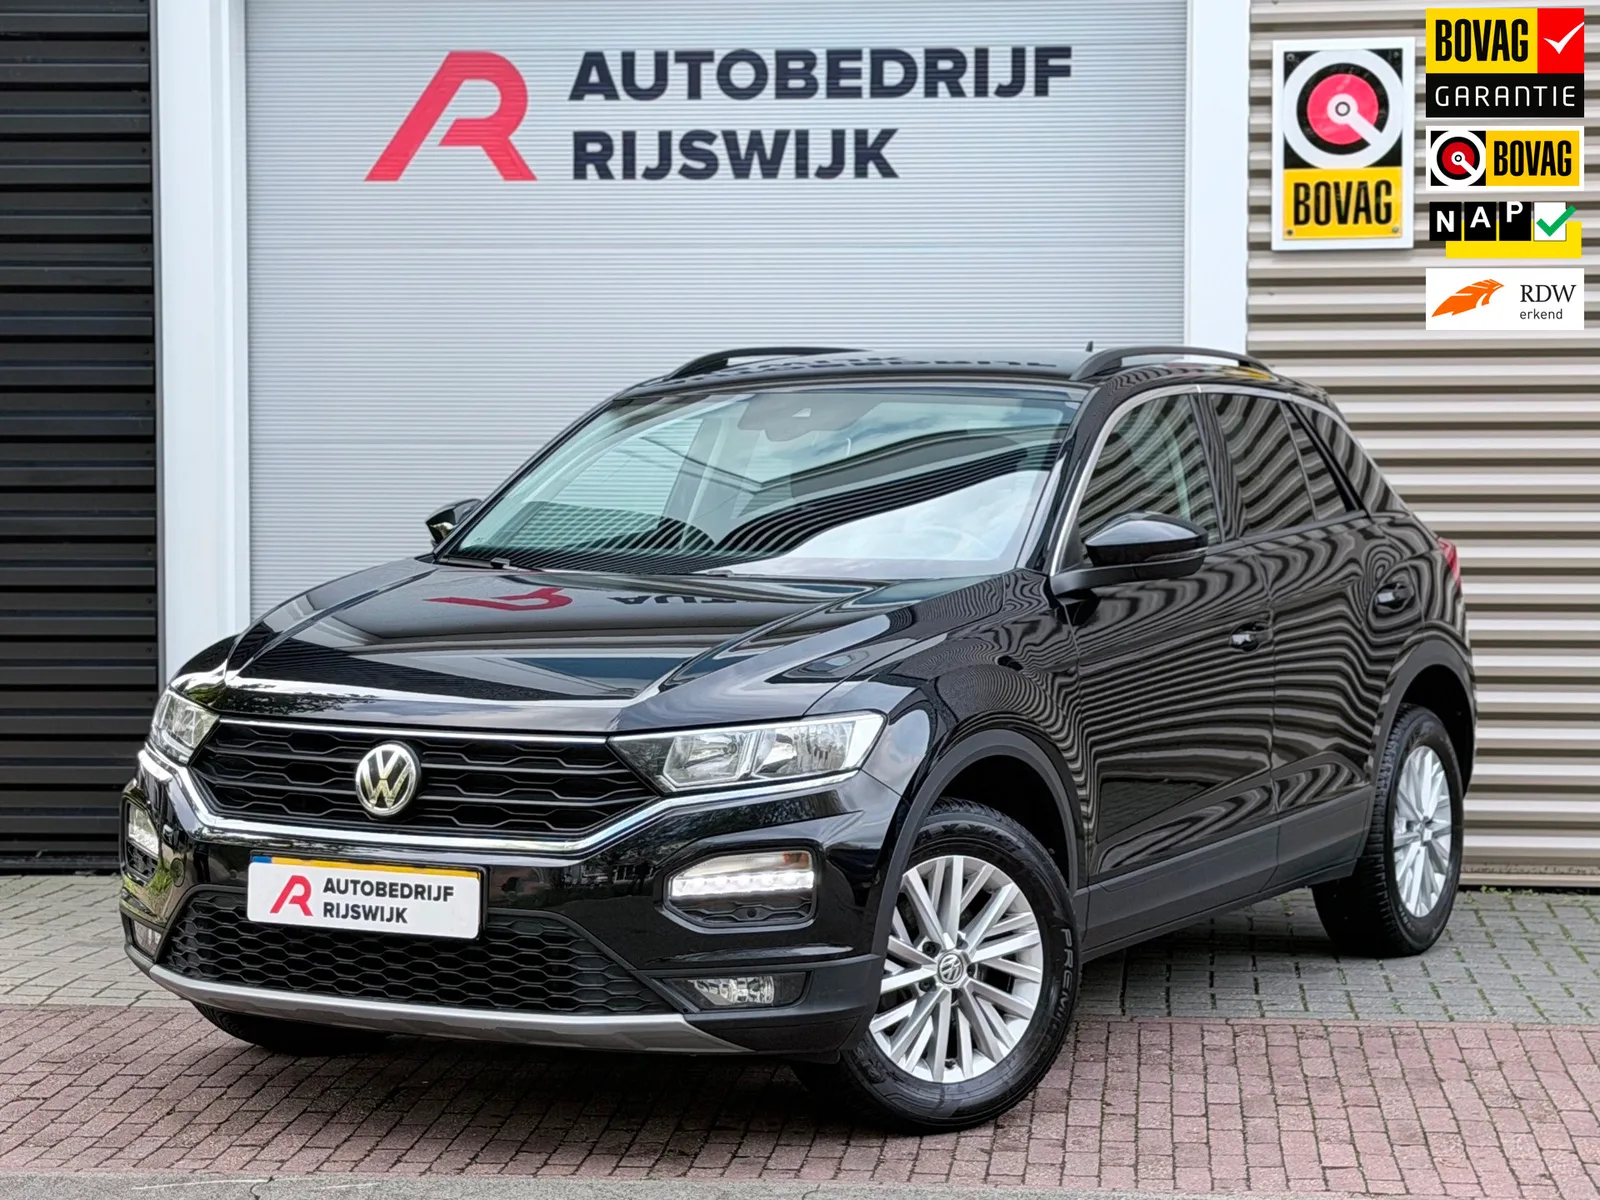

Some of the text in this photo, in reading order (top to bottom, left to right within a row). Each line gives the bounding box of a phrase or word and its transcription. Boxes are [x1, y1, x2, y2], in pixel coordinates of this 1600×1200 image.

[568, 46, 1072, 101] AUTOBEDRIJF
[573, 128, 899, 181] RIJSWIJK
[1293, 180, 1393, 226] BOVAG
[323, 877, 454, 902] AUTOBEDRIJF
[323, 902, 408, 923] RIJSWIJK
